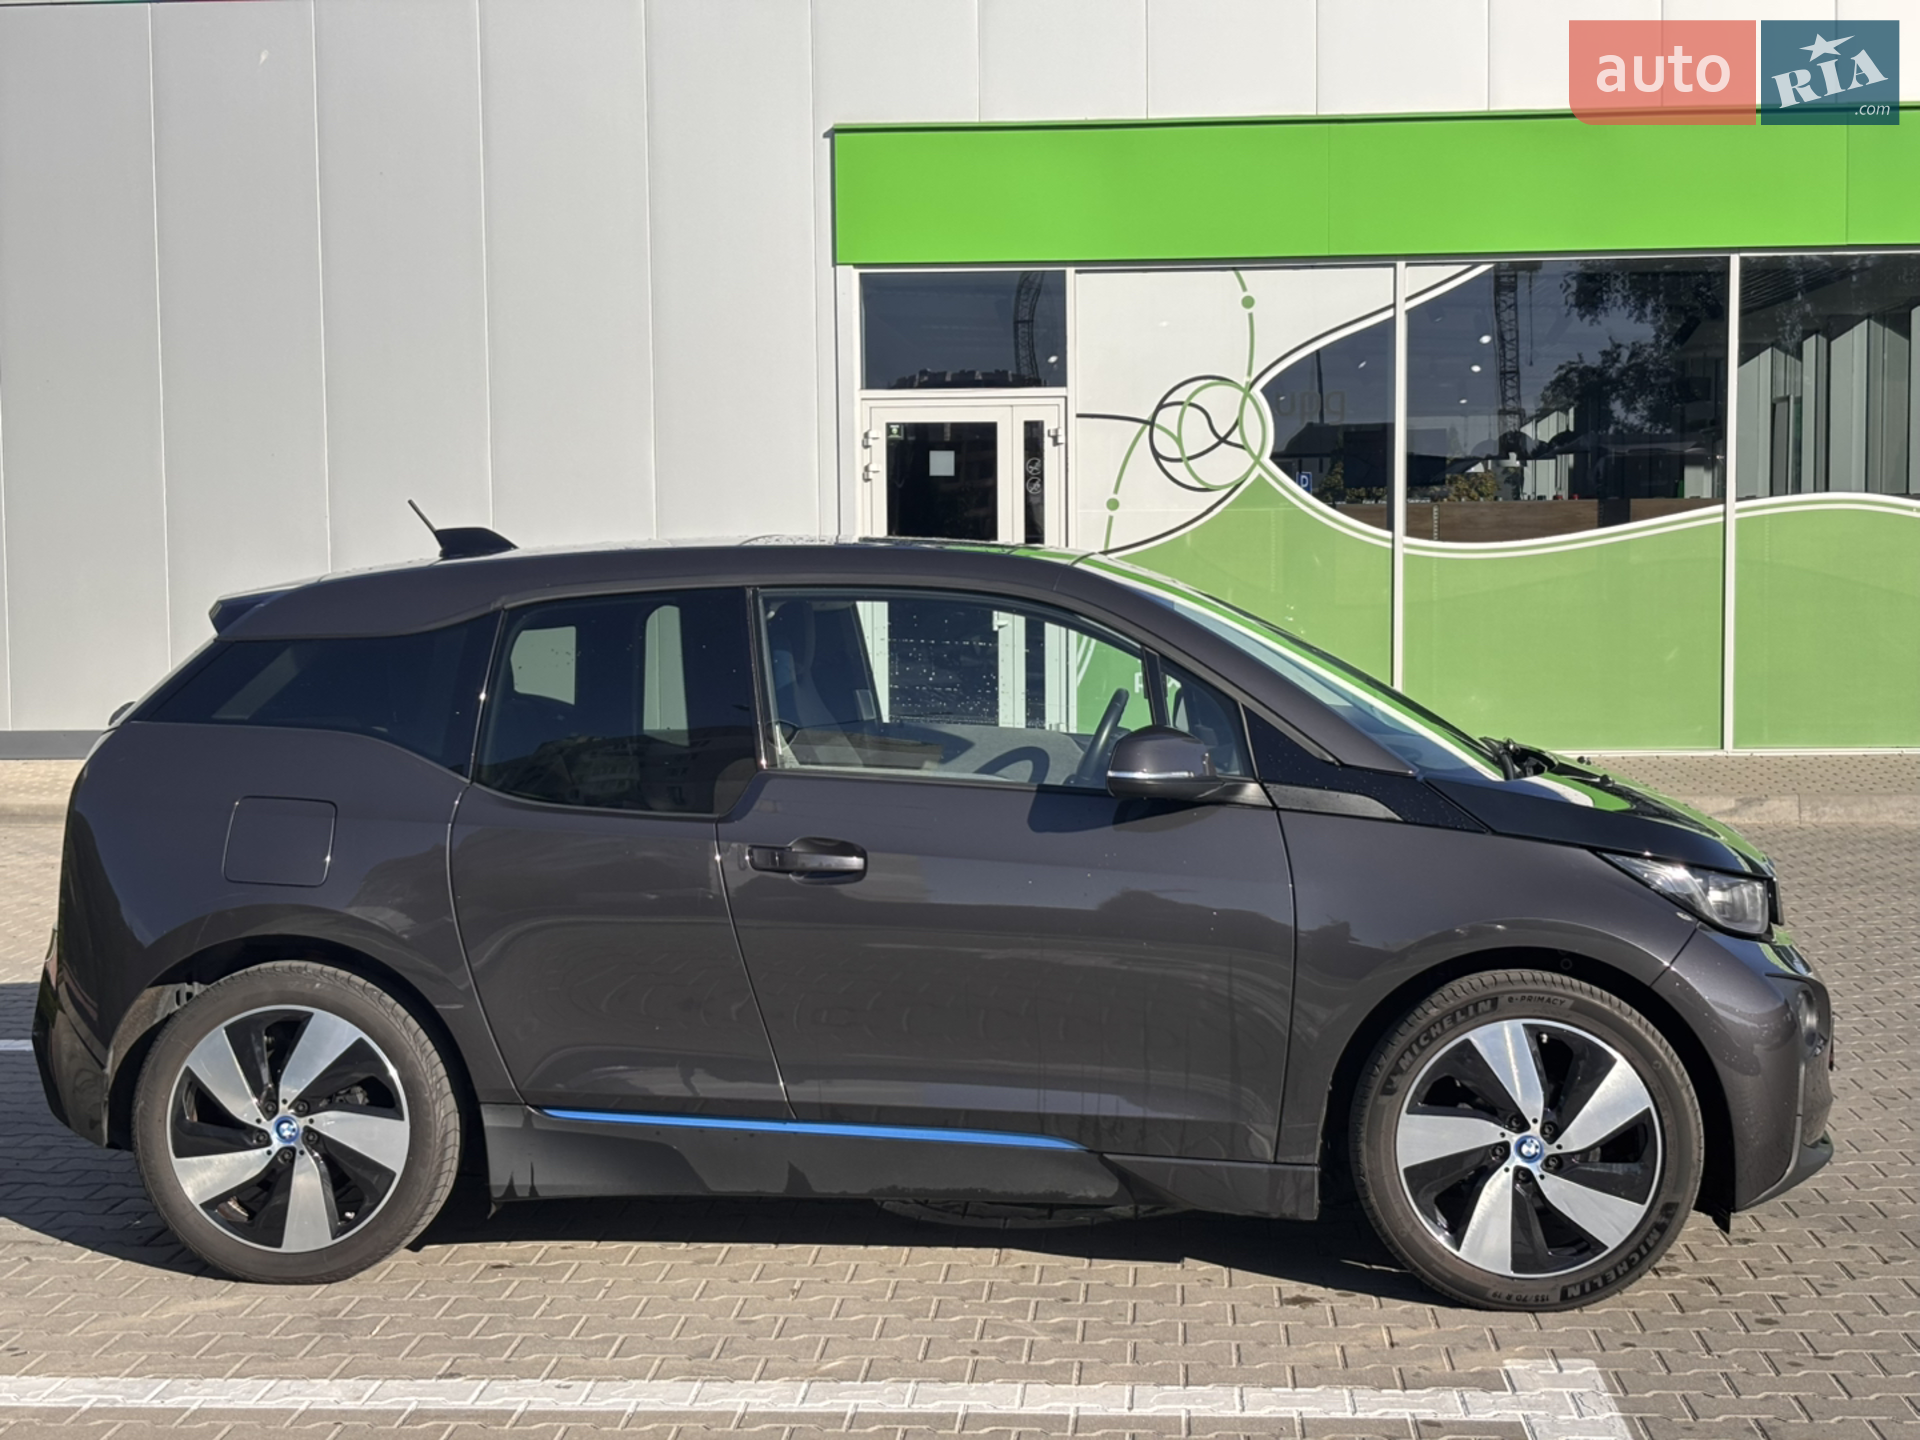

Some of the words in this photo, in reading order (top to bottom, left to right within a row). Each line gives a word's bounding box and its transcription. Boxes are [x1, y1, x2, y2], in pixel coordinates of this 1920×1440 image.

[1398, 998, 1493, 1071] MICHELIN
[1567, 1227, 1661, 1298] MICHELIN
[1505, 1293, 1513, 1301] R
[1515, 1294, 1550, 1303] 155/70
